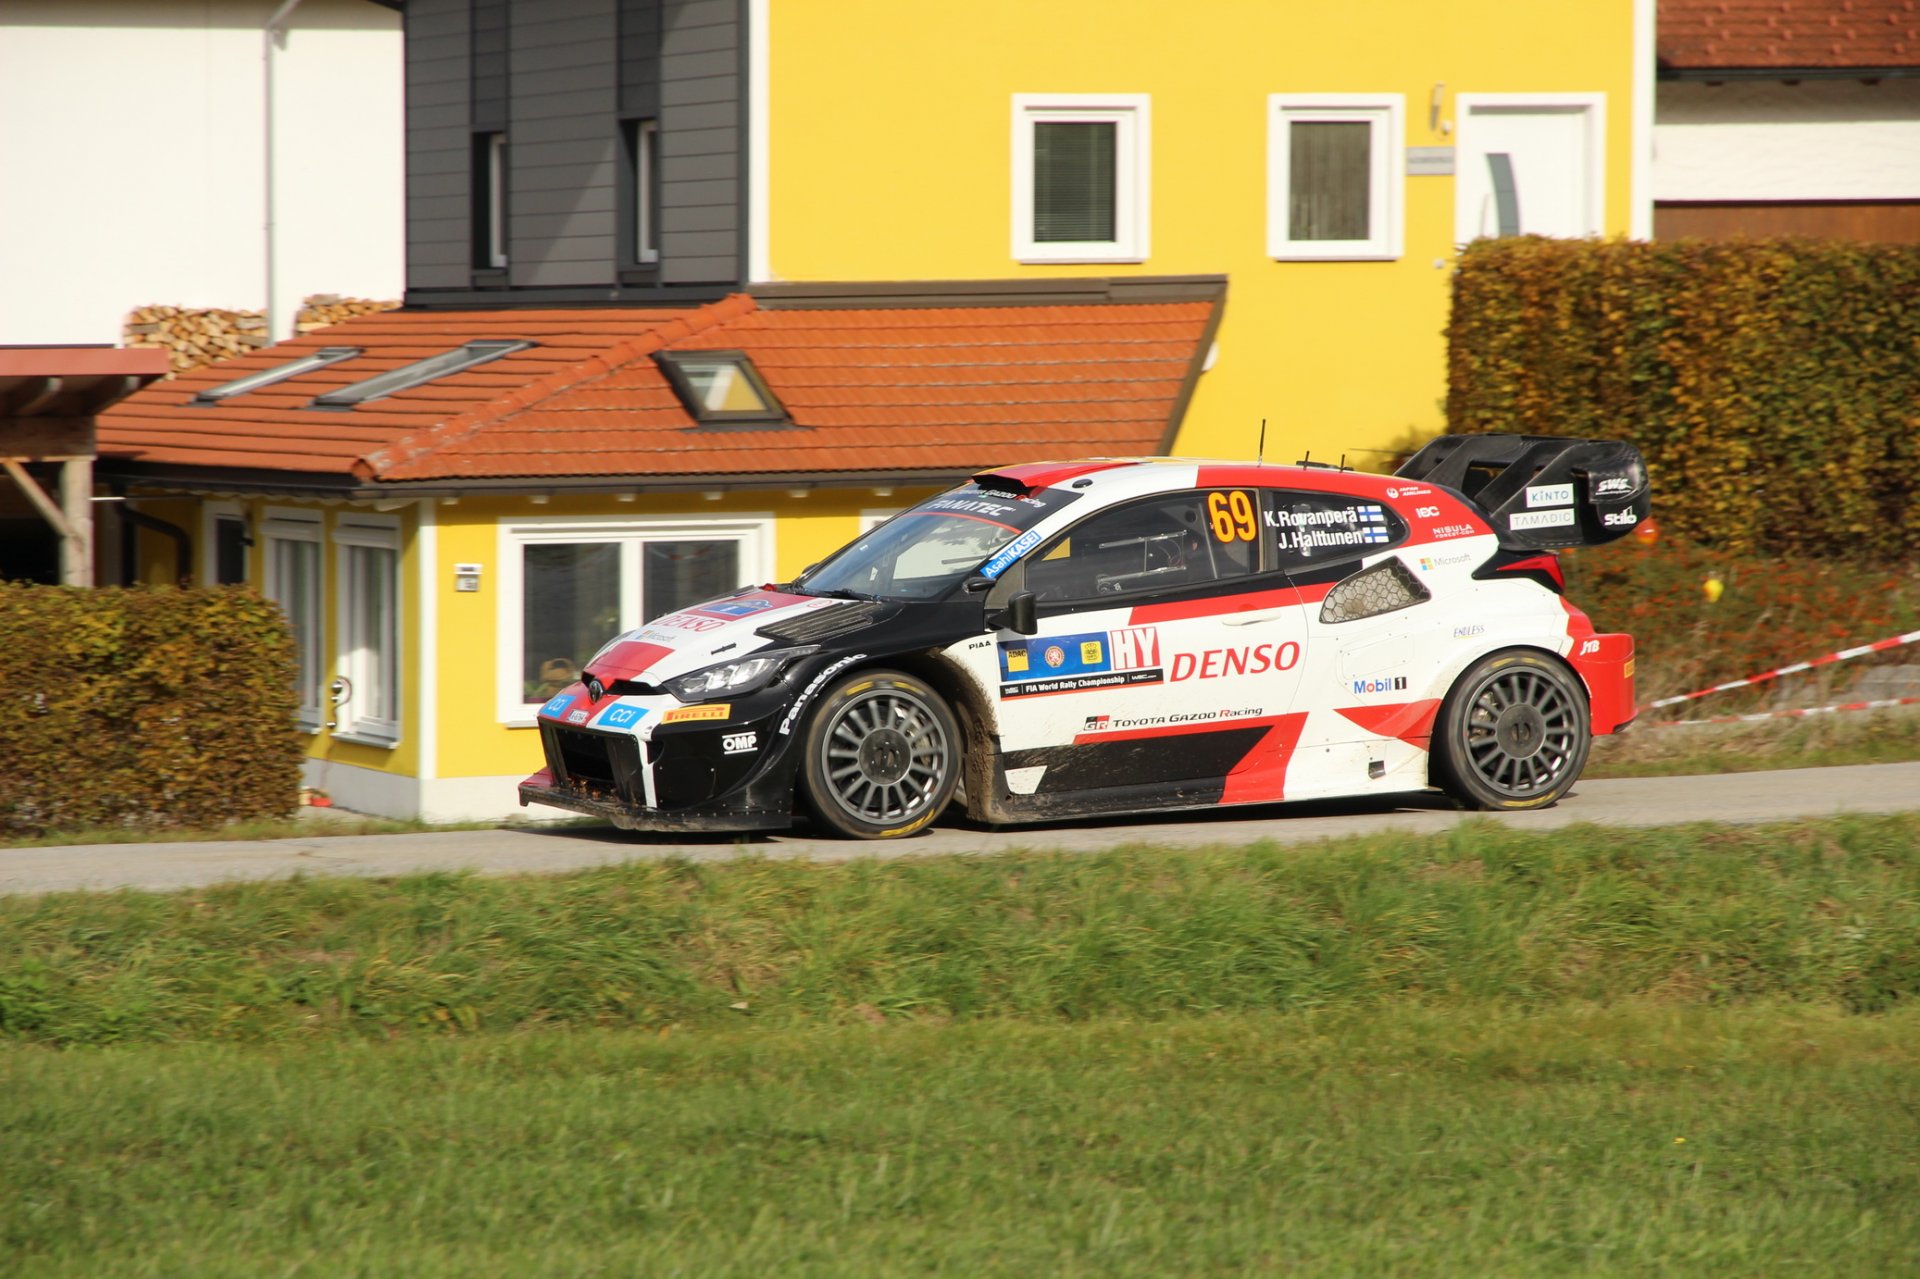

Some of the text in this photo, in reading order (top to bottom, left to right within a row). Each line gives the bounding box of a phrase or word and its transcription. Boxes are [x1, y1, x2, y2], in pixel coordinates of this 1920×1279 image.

[926, 499, 1014, 516] FANATEC
[1604, 505, 1637, 526] Stilo
[1207, 490, 1257, 543] 69
[1514, 511, 1572, 526] TAMADIC
[1432, 523, 1473, 535] NISULA
[1278, 529, 1363, 550] J.Halttunen
[1433, 552, 1472, 566] Microsoft
[652, 614, 726, 633] DENSO
[1453, 624, 1485, 638] ENDLESS
[968, 640, 991, 650] PIAA
[1579, 639, 1600, 656] JTB
[1169, 641, 1300, 682] DENSO
[1025, 684, 1038, 693] FIA
[1038, 682, 1059, 692] World
[1060, 680, 1077, 689] Rally
[1078, 675, 1125, 687] Championship
[1353, 677, 1392, 694] Mobil
[779, 653, 868, 736] Panasonic
[665, 706, 726, 721] PIRELLI
[1113, 716, 1166, 728] TOYOTA
[1169, 710, 1217, 723] GAZOO
[1219, 706, 1263, 719] Racing
[722, 735, 757, 751] OMP
